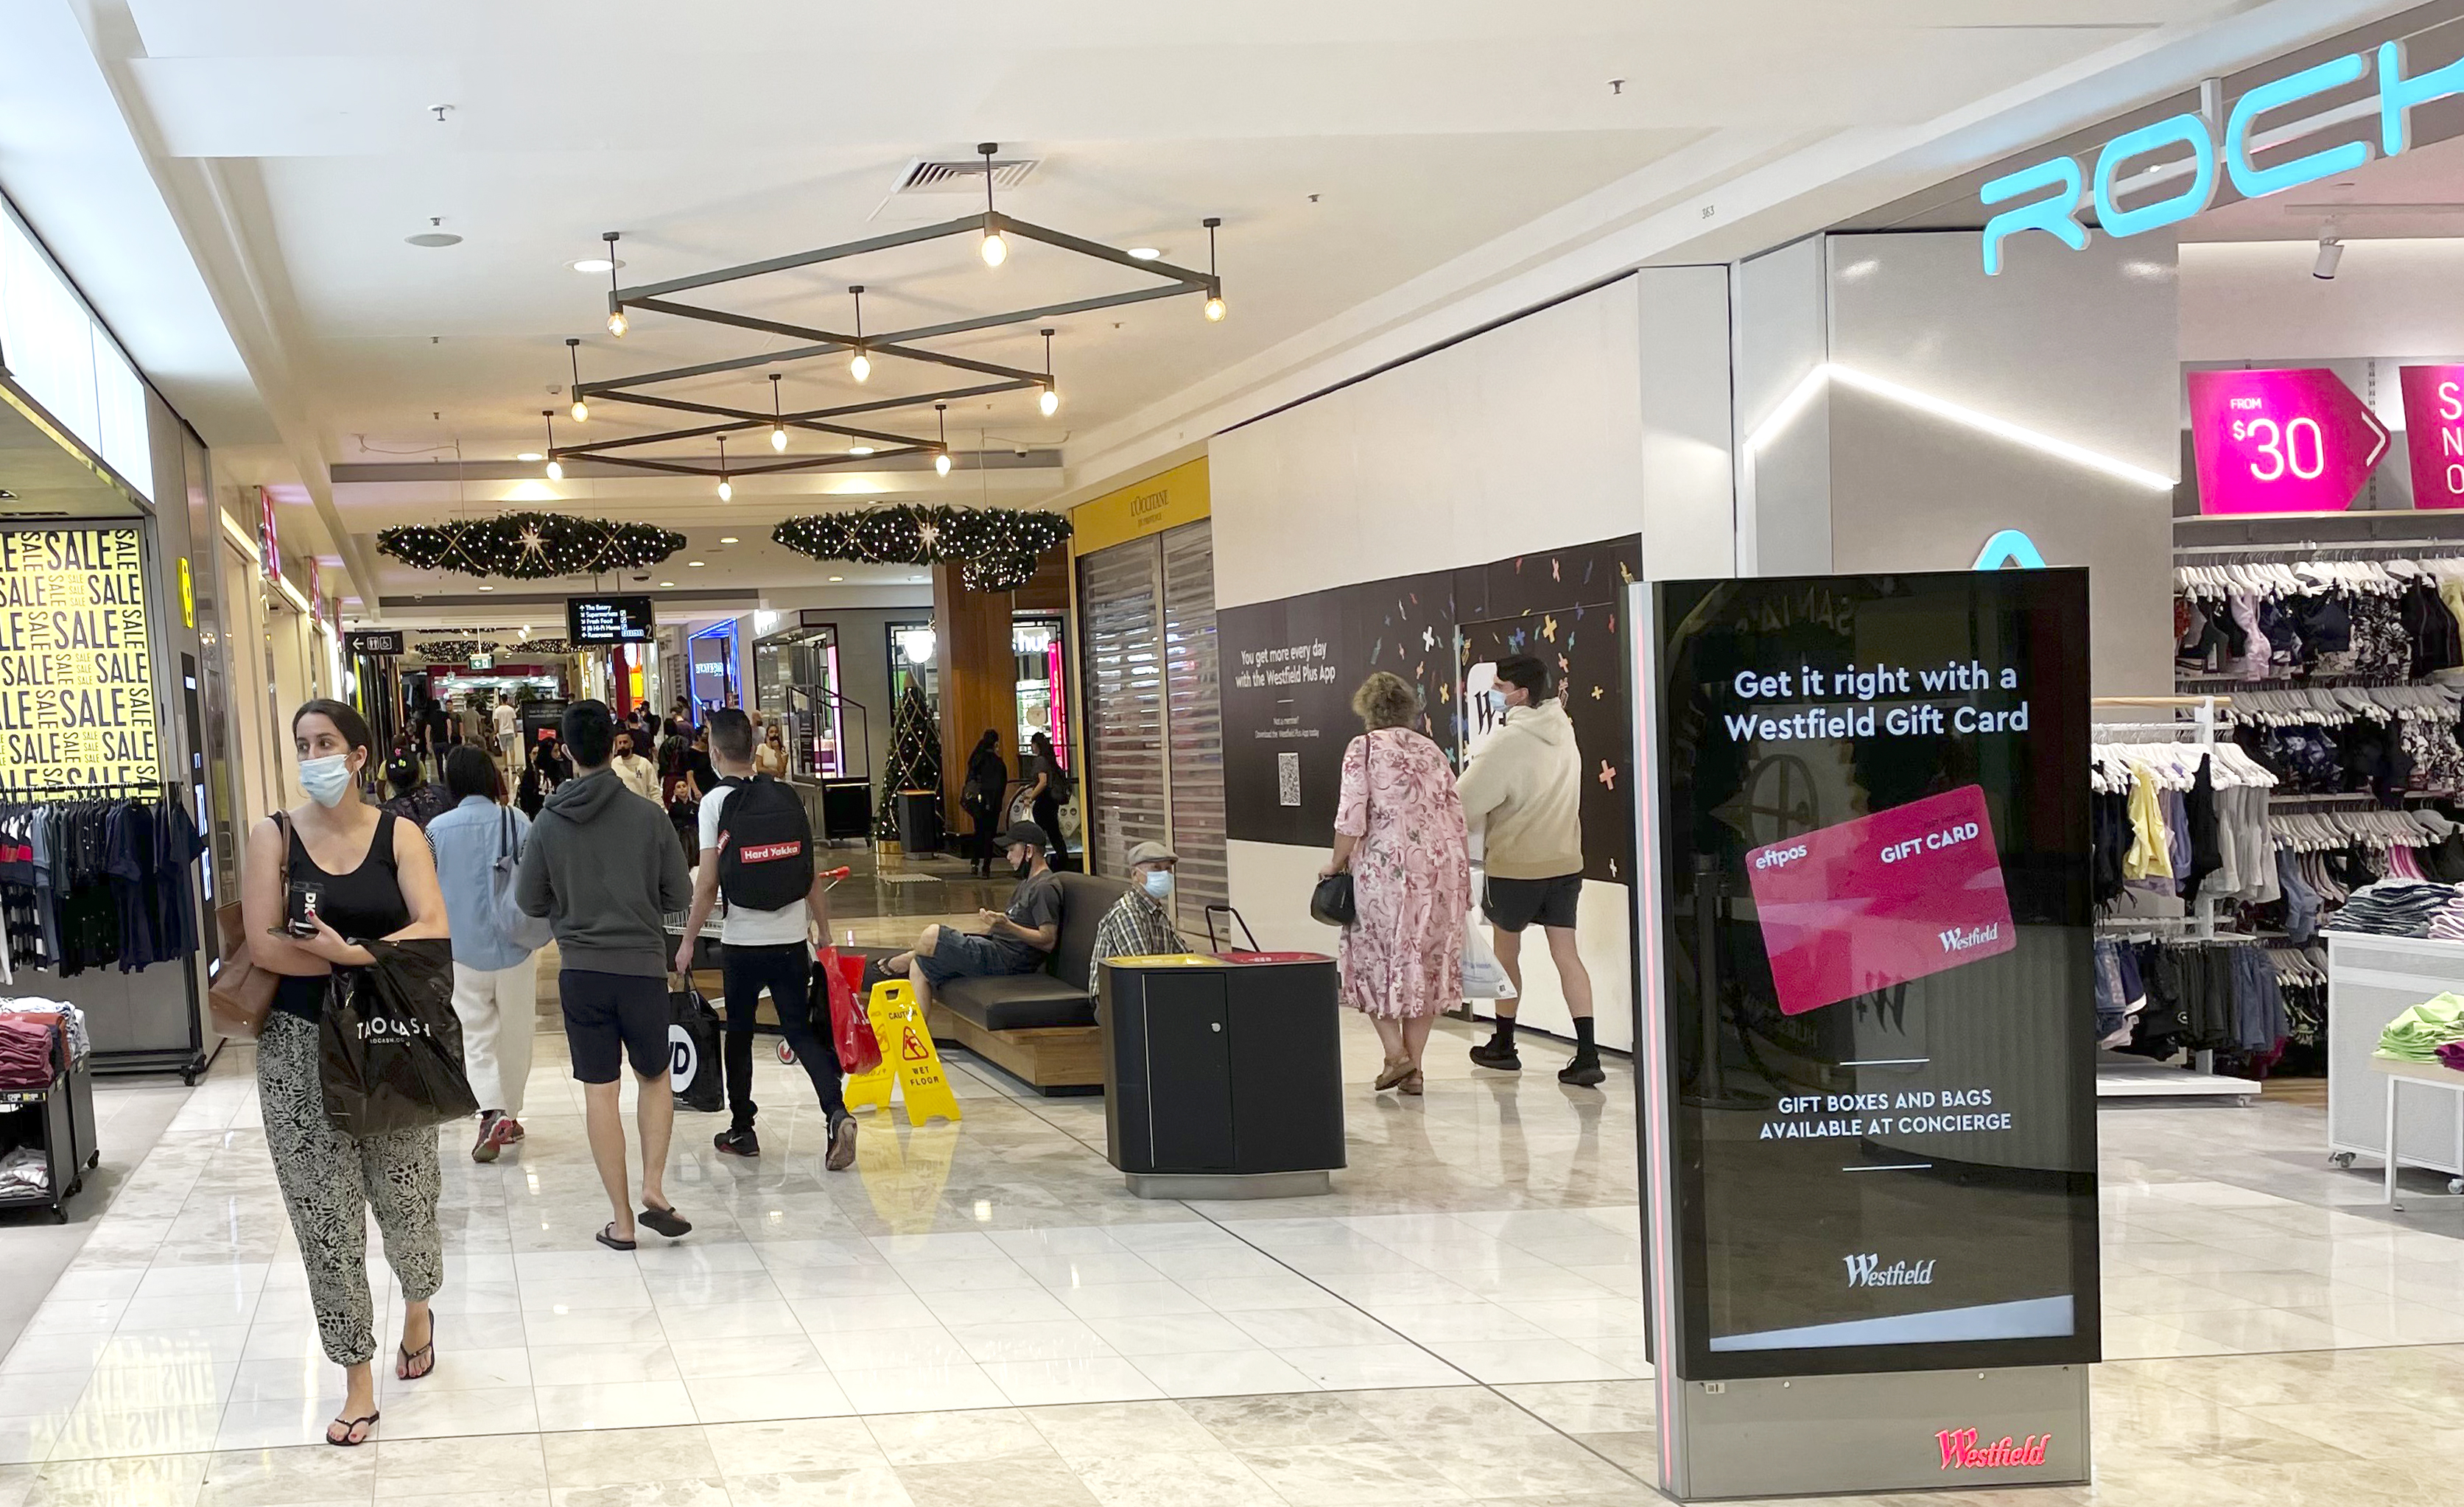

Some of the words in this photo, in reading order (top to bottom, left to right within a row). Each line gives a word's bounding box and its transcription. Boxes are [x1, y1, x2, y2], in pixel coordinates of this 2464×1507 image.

[1702, 205, 1715, 219] 363
[2230, 398, 2262, 410] FROM
[2233, 417, 2325, 481] $30
[21, 531, 43, 572] SALE
[45, 530, 112, 571] SALE
[115, 530, 138, 570] SALE
[49, 575, 66, 606] SALE
[68, 575, 84, 584] SALE
[69, 586, 85, 595] SALE
[88, 574, 141, 605] SALE
[70, 597, 85, 607] SALE
[29, 611, 51, 650] SALE
[53, 610, 119, 650] SALE
[122, 609, 145, 649] SALE
[645, 624, 653, 639] 2
[76, 653, 90, 662] SALE
[77, 664, 91, 673] SALE
[95, 653, 148, 684] SALE
[1241, 650, 1254, 665] You
[1255, 648, 1268, 668] get
[1270, 648, 1289, 662] more
[1291, 644, 1311, 661] every
[1313, 638, 1327, 660] day
[1, 655, 55, 686] SALE
[56, 653, 74, 685] SALE
[77, 675, 92, 685] SALE
[1235, 670, 1252, 688] with
[1252, 670, 1265, 686] the
[1266, 664, 1301, 685] Westfield
[1302, 664, 1318, 682] Plus
[1319, 664, 1335, 684] App
[1734, 670, 1792, 698] Get
[1802, 665, 1825, 696] it
[1834, 663, 1910, 700] right
[1919, 660, 1990, 692] with
[2000, 667, 2018, 689] a
[36, 690, 58, 728] SALE
[60, 688, 127, 728] SALE
[130, 688, 152, 727] SALE
[1724, 707, 1875, 742] Westfield
[1885, 706, 1944, 736] Gift
[1954, 701, 2029, 733] Card
[9, 733, 61, 765] SALE
[63, 732, 81, 763] SALE
[83, 731, 97, 740] SALE
[84, 742, 99, 751] SALE
[102, 731, 155, 762] SALE
[85, 754, 99, 763] SALE
[744, 849, 769, 860] Hard
[770, 846, 798, 857] Yakka
[1755, 844, 1808, 871] eftpos
[1880, 837, 1923, 864] GIFT
[1926, 822, 1979, 850] CARD
[1938, 922, 1998, 953] Westfield
[910, 1076, 940, 1086] FLOOR
[911, 1066, 930, 1075] WET
[1778, 1096, 1821, 1114] GIFT
[1827, 1093, 1888, 1112] BOXES
[1895, 1091, 1935, 1109] AND
[1941, 1089, 1992, 1107] BAGS
[1759, 1117, 1862, 1140] AVAILABLE
[1868, 1117, 1894, 1136] AT
[1898, 1113, 2012, 1135] CONCIERGE
[1843, 1253, 1937, 1288] Westfield
[1934, 1426, 2051, 1471] Westfield
